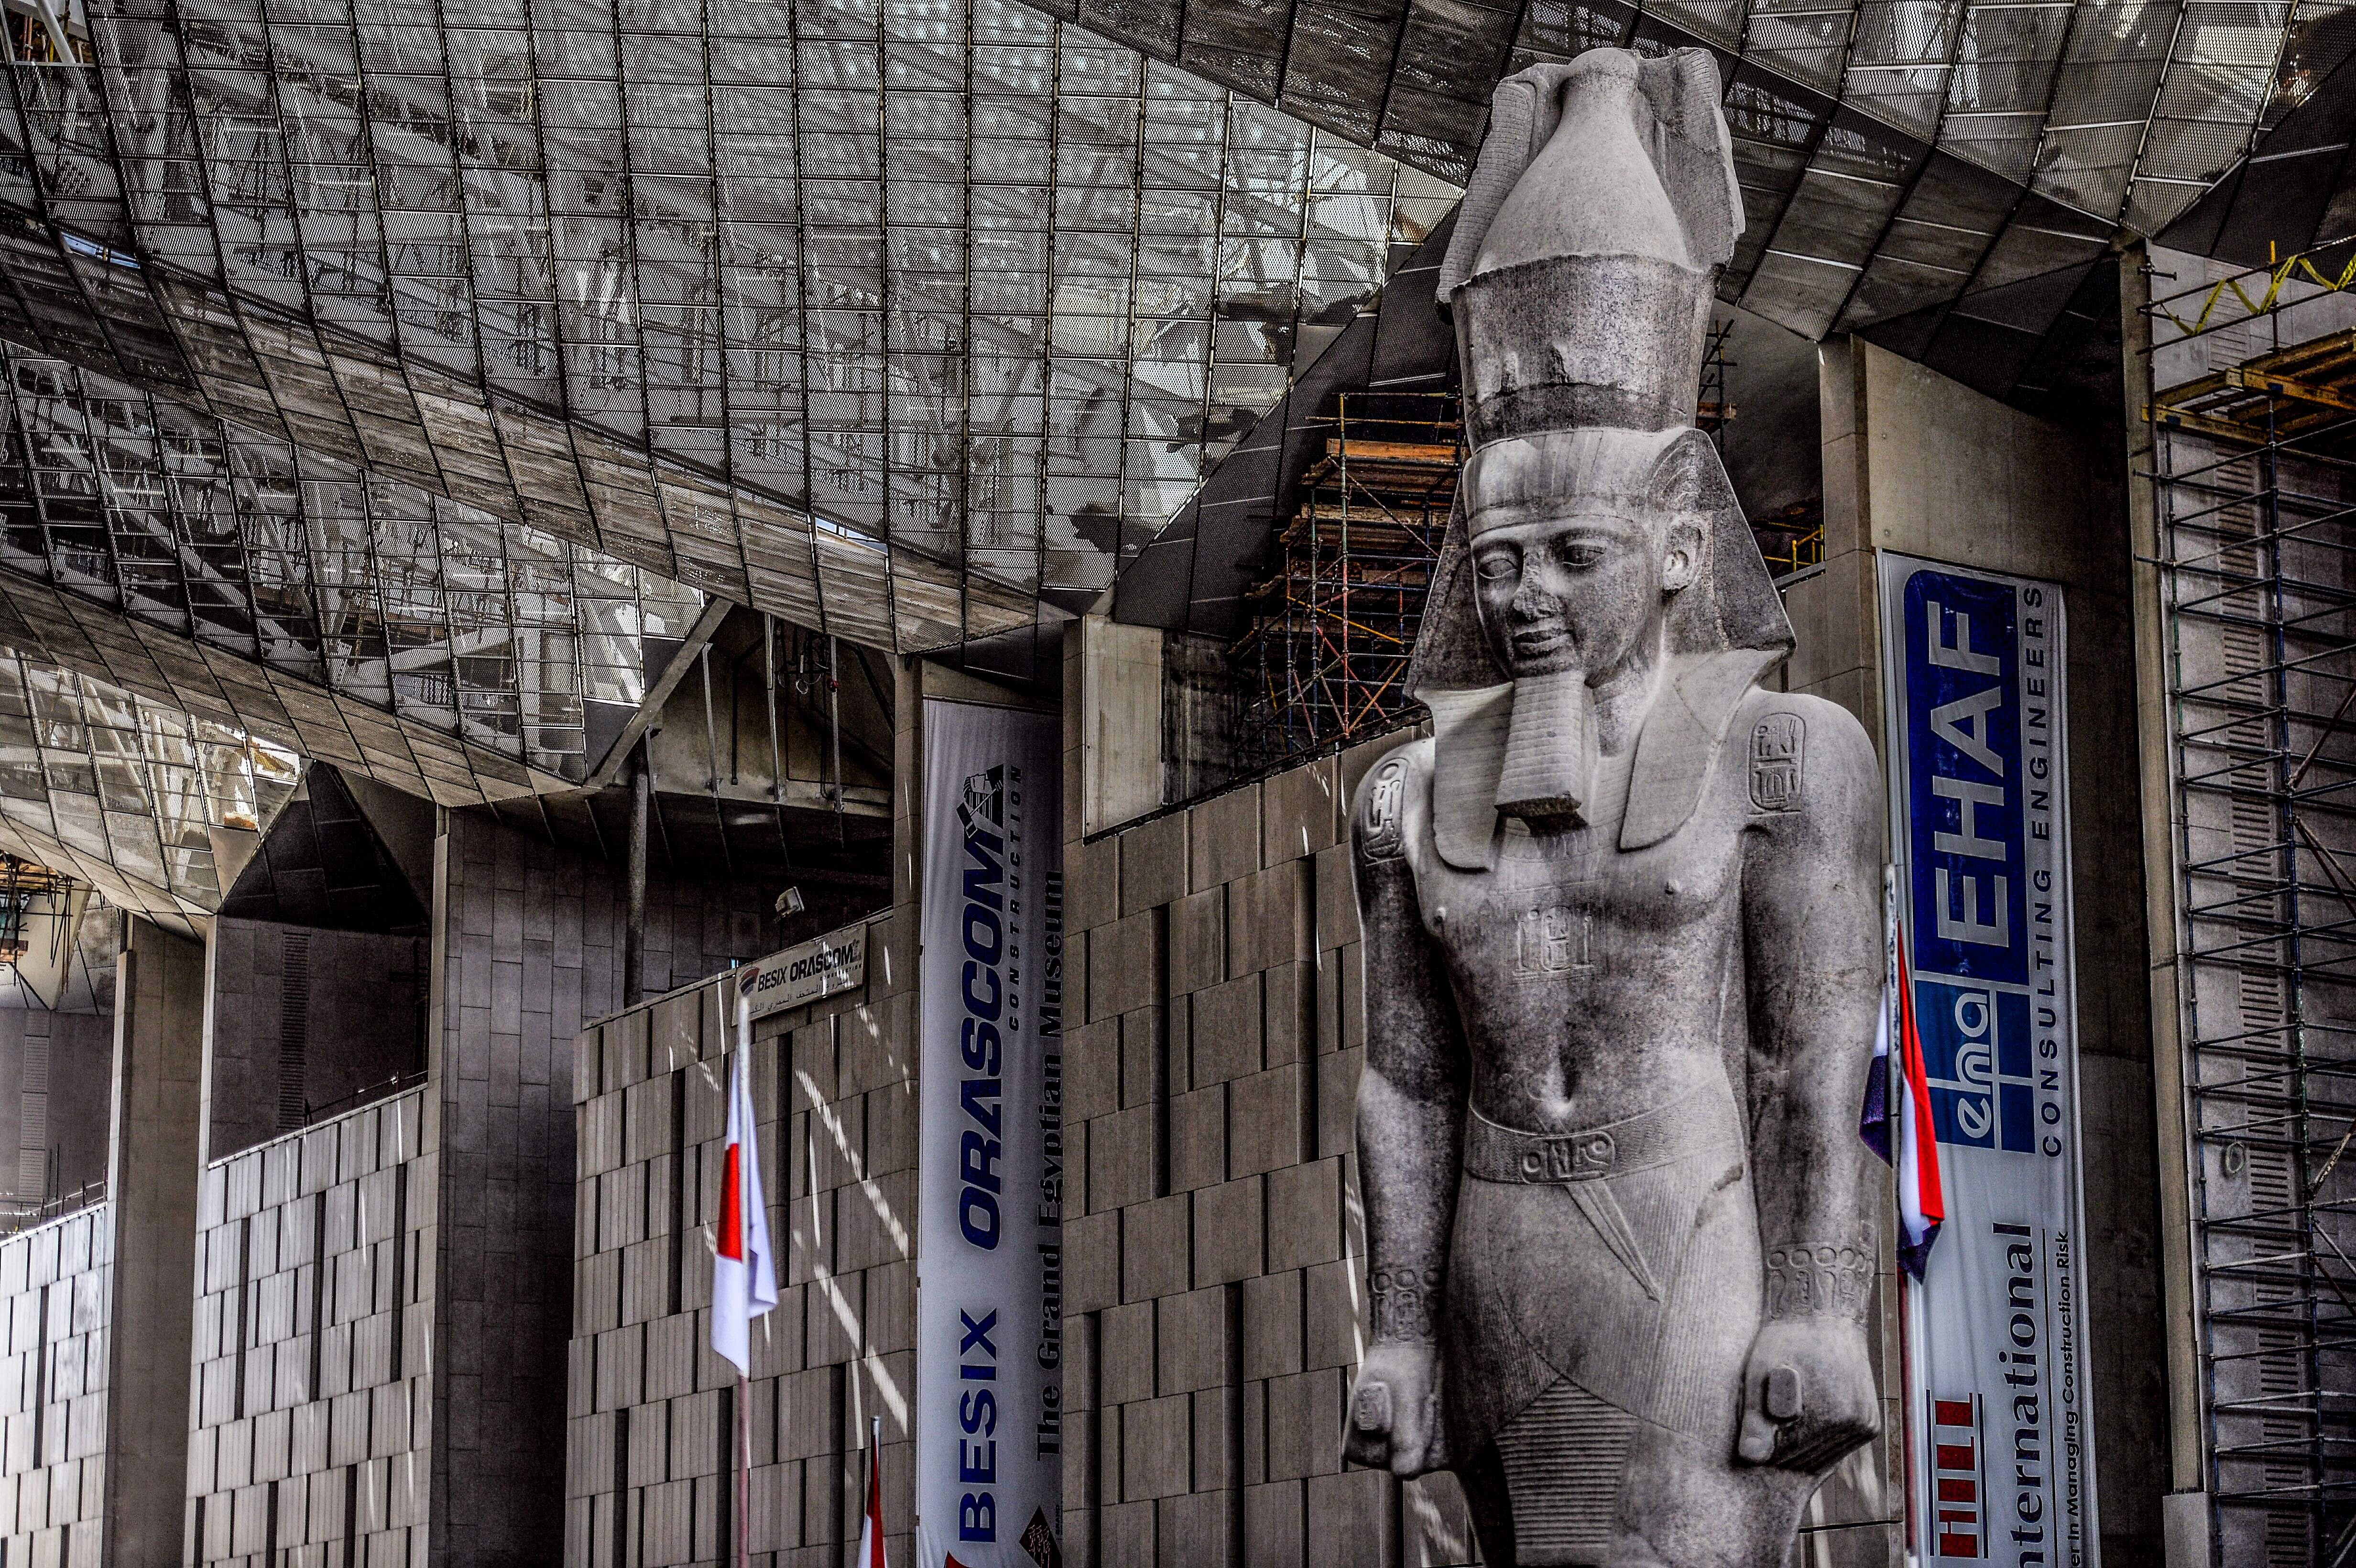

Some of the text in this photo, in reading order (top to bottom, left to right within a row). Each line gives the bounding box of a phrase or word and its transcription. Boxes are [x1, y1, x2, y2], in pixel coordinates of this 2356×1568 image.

[1928, 601, 2009, 948] EHAF
[1008, 765, 1022, 1032] CONSTRUCTION
[2022, 588, 2063, 1157] CONSULTING ENGINEERS
[757, 943, 853, 992] BESIX ORASCOM
[958, 826, 1003, 1542] BESIX ORASCOM
[1036, 870, 1063, 1461] The Grand Egyptian Museum
[2055, 1231, 2070, 1269] Risk
[2057, 1276, 2074, 1404] Construction
[1935, 1392, 1978, 1558] HILL
[2064, 1411, 2080, 1517] Managing
[2067, 1523, 2080, 1540] in
